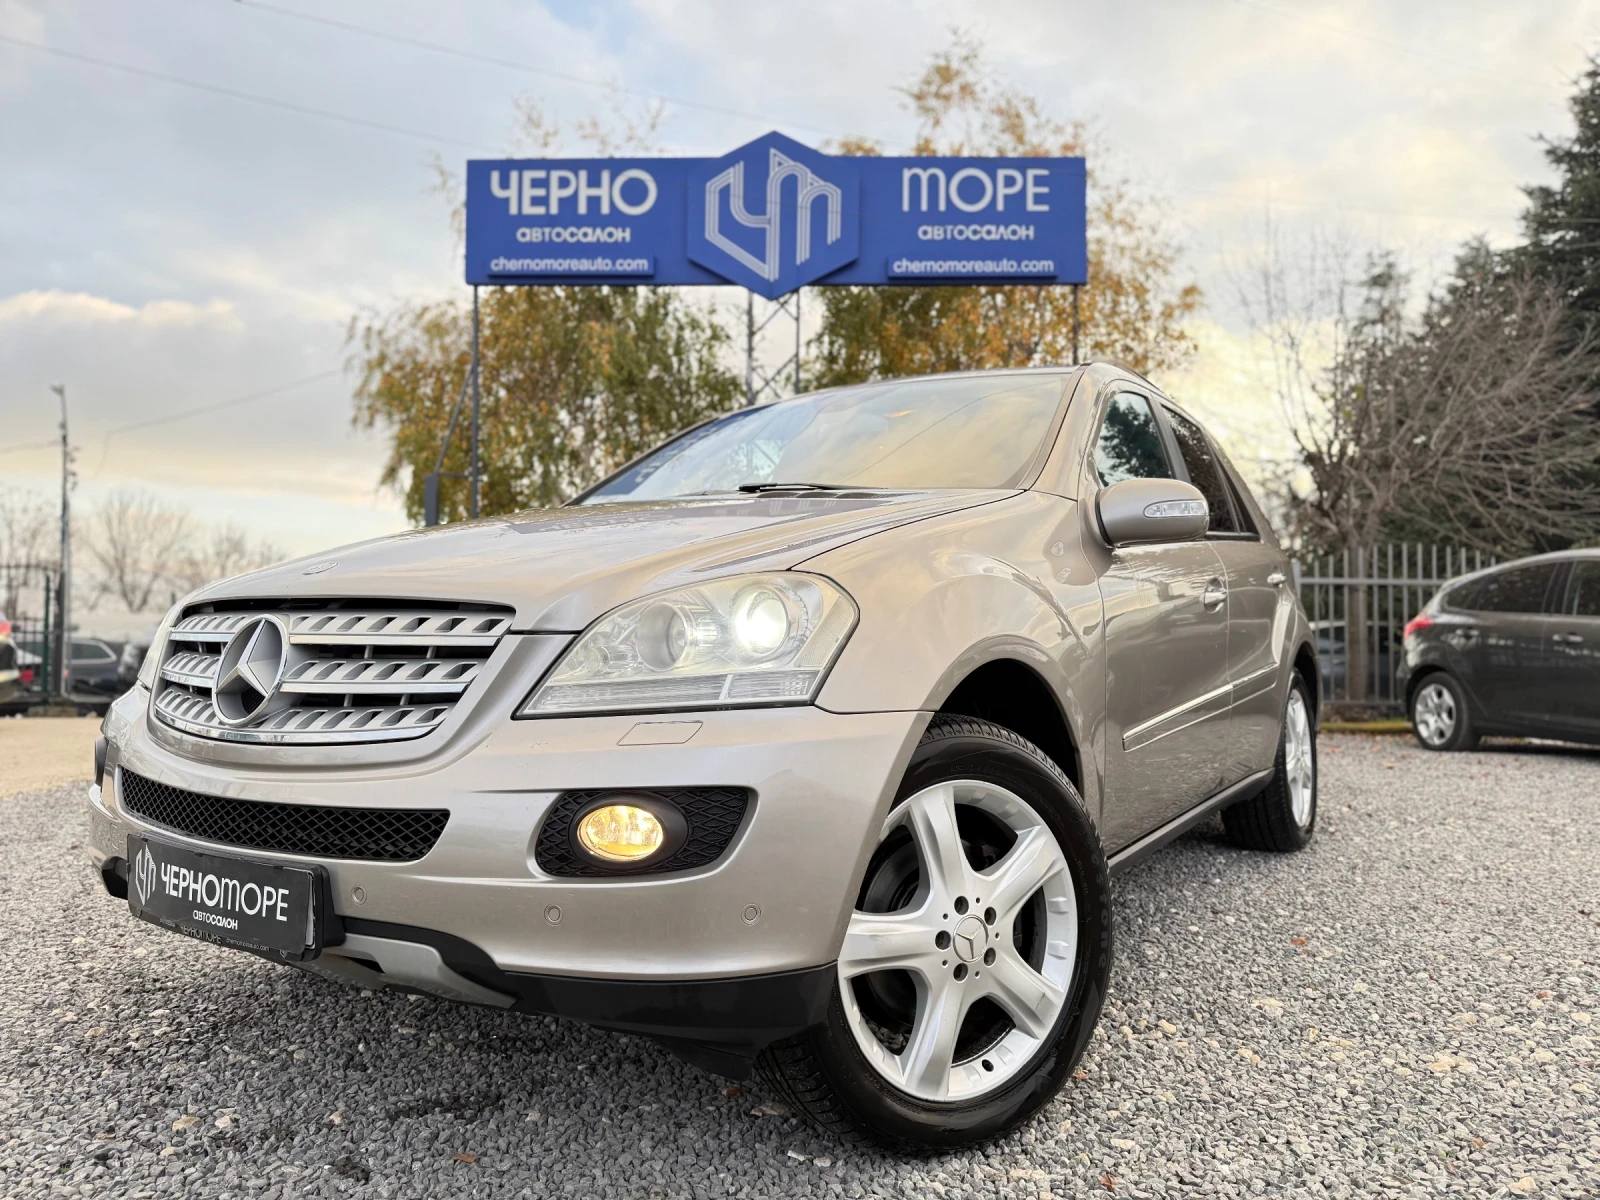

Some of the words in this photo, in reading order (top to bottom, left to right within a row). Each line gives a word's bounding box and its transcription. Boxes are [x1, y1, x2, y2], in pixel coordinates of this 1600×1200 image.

[490, 168, 658, 215] ЧЕРНО
[902, 167, 1050, 212] МОРЕ
[516, 227, 631, 243] автосалон
[917, 224, 1035, 241] автосалон
[490, 257, 648, 272] chernomoreauto.com
[893, 258, 1054, 273] chernomoreauto.com
[161, 862, 290, 922] ЧЕРНОМОРЕ
[192, 910, 238, 930] автосалон
